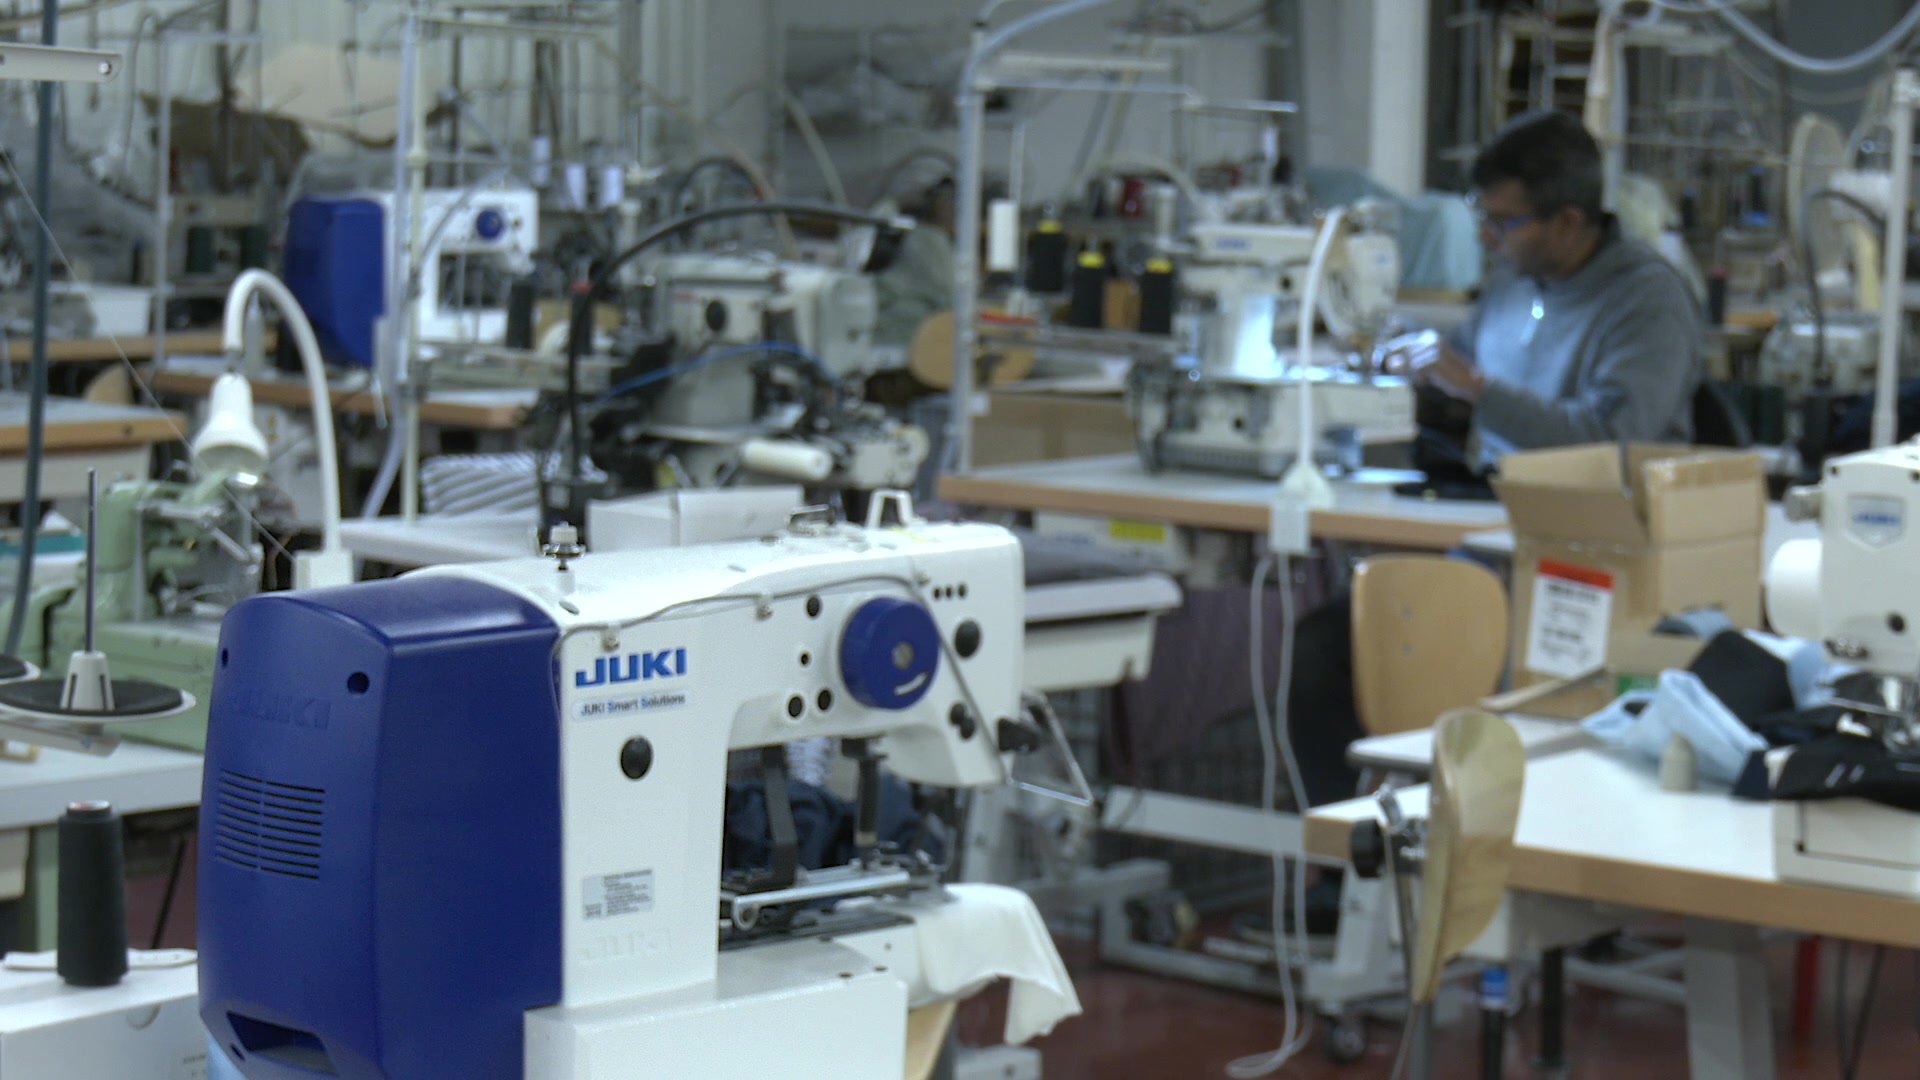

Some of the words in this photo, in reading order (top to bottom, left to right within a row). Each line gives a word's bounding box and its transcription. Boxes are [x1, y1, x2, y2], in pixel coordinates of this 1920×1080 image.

[575, 647, 687, 687] JUKI
[581, 703, 605, 717] JUKI
[607, 700, 638, 713] Smart
[641, 695, 685, 710] Solutions
